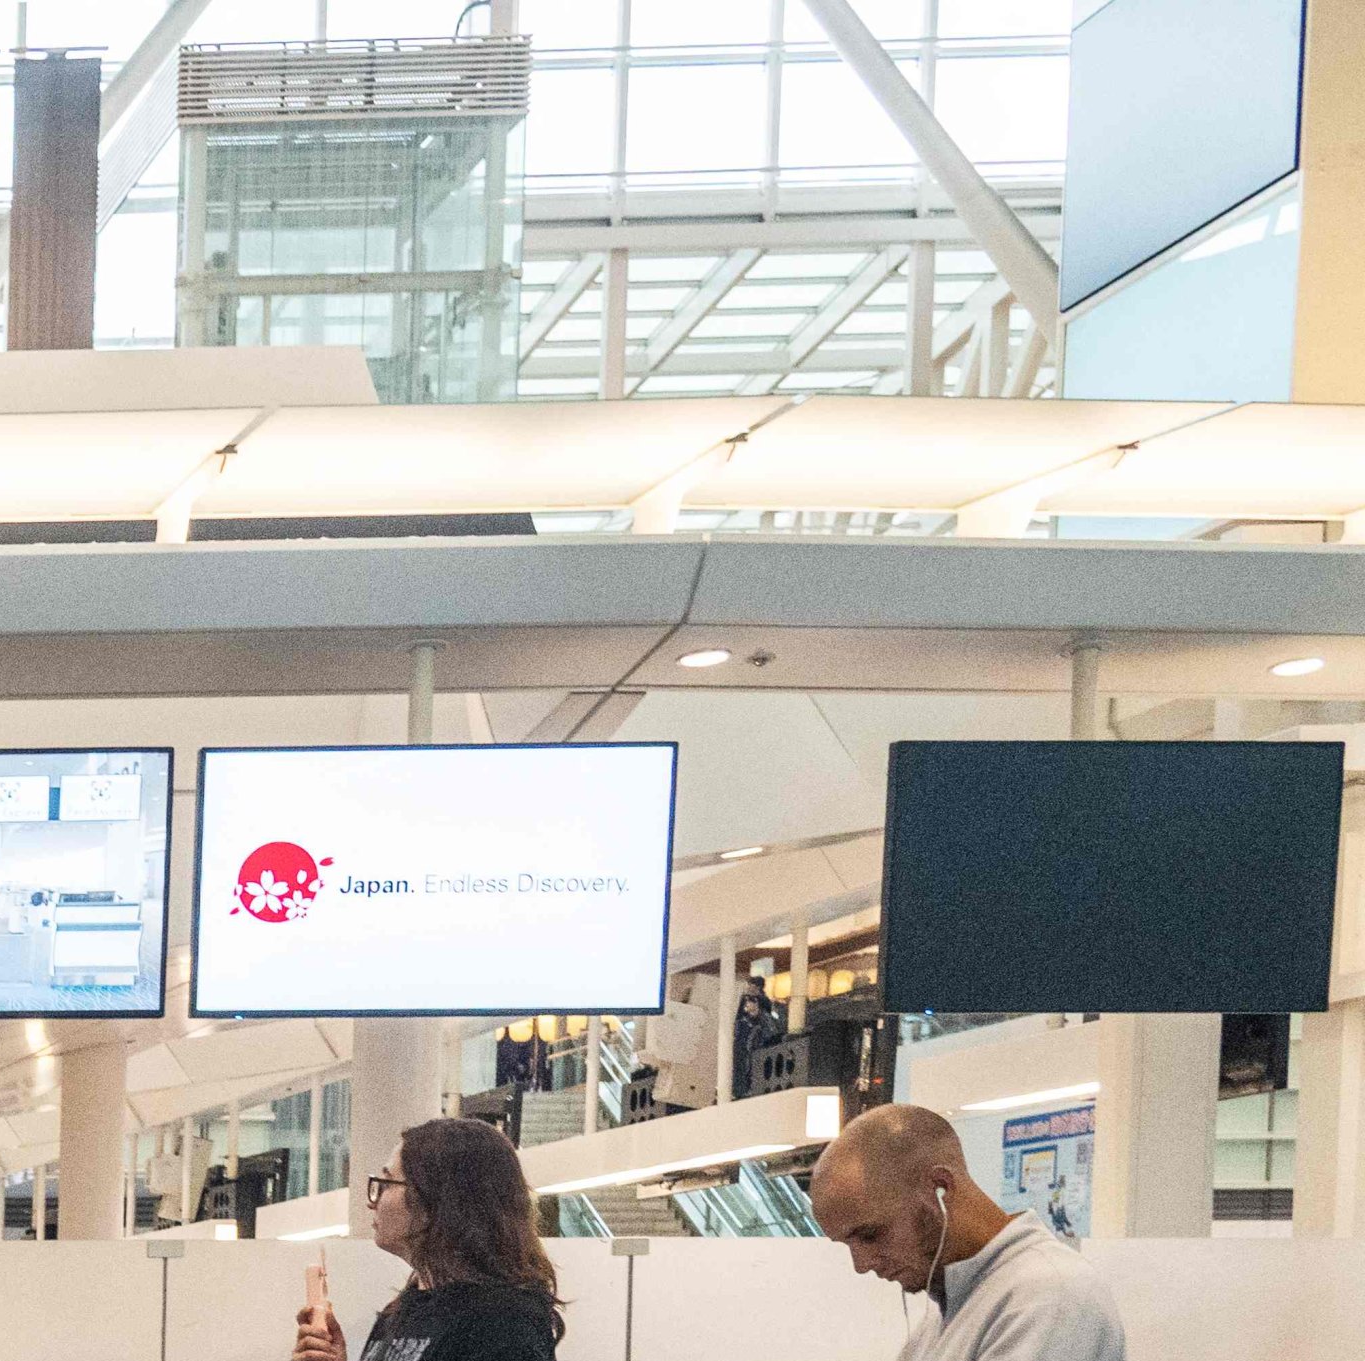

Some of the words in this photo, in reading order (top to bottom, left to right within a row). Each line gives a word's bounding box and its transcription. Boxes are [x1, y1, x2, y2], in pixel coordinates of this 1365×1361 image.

[339, 874, 416, 898] Japan.
[424, 874, 509, 895] Endless
[518, 872, 630, 897] Discovery.
